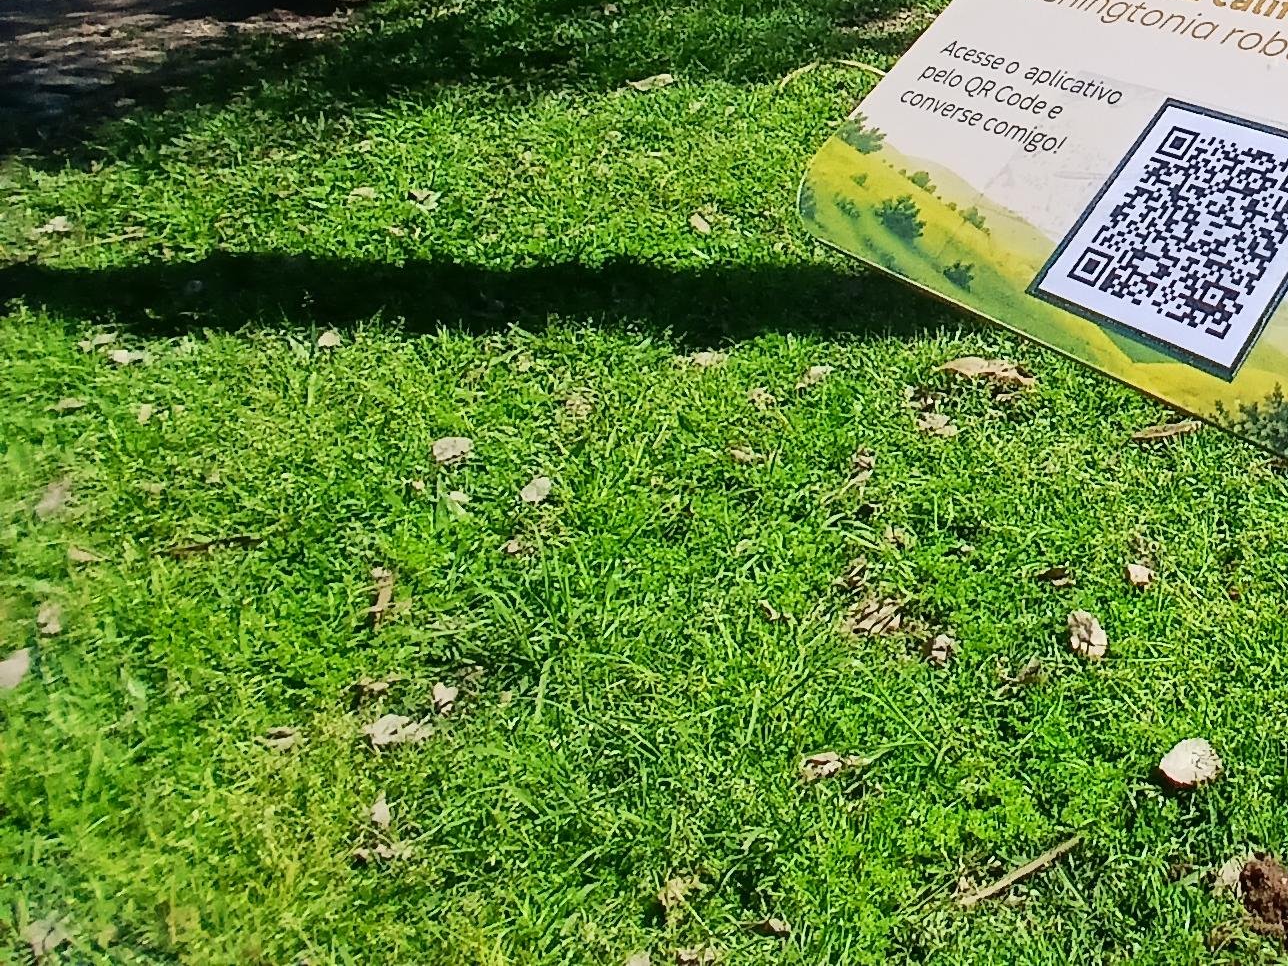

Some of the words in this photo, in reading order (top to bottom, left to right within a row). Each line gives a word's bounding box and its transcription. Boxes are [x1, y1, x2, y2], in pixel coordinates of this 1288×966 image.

[918, 64, 963, 88] pelo
[964, 76, 995, 99] QR
[994, 85, 1048, 114] Code
[1047, 104, 1064, 120] e
[940, 40, 1005, 70] Acesse
[1005, 60, 1020, 74] o
[1024, 65, 1123, 105] aplicativo
[900, 89, 983, 126] converse
[983, 116, 1068, 154] comigo!
